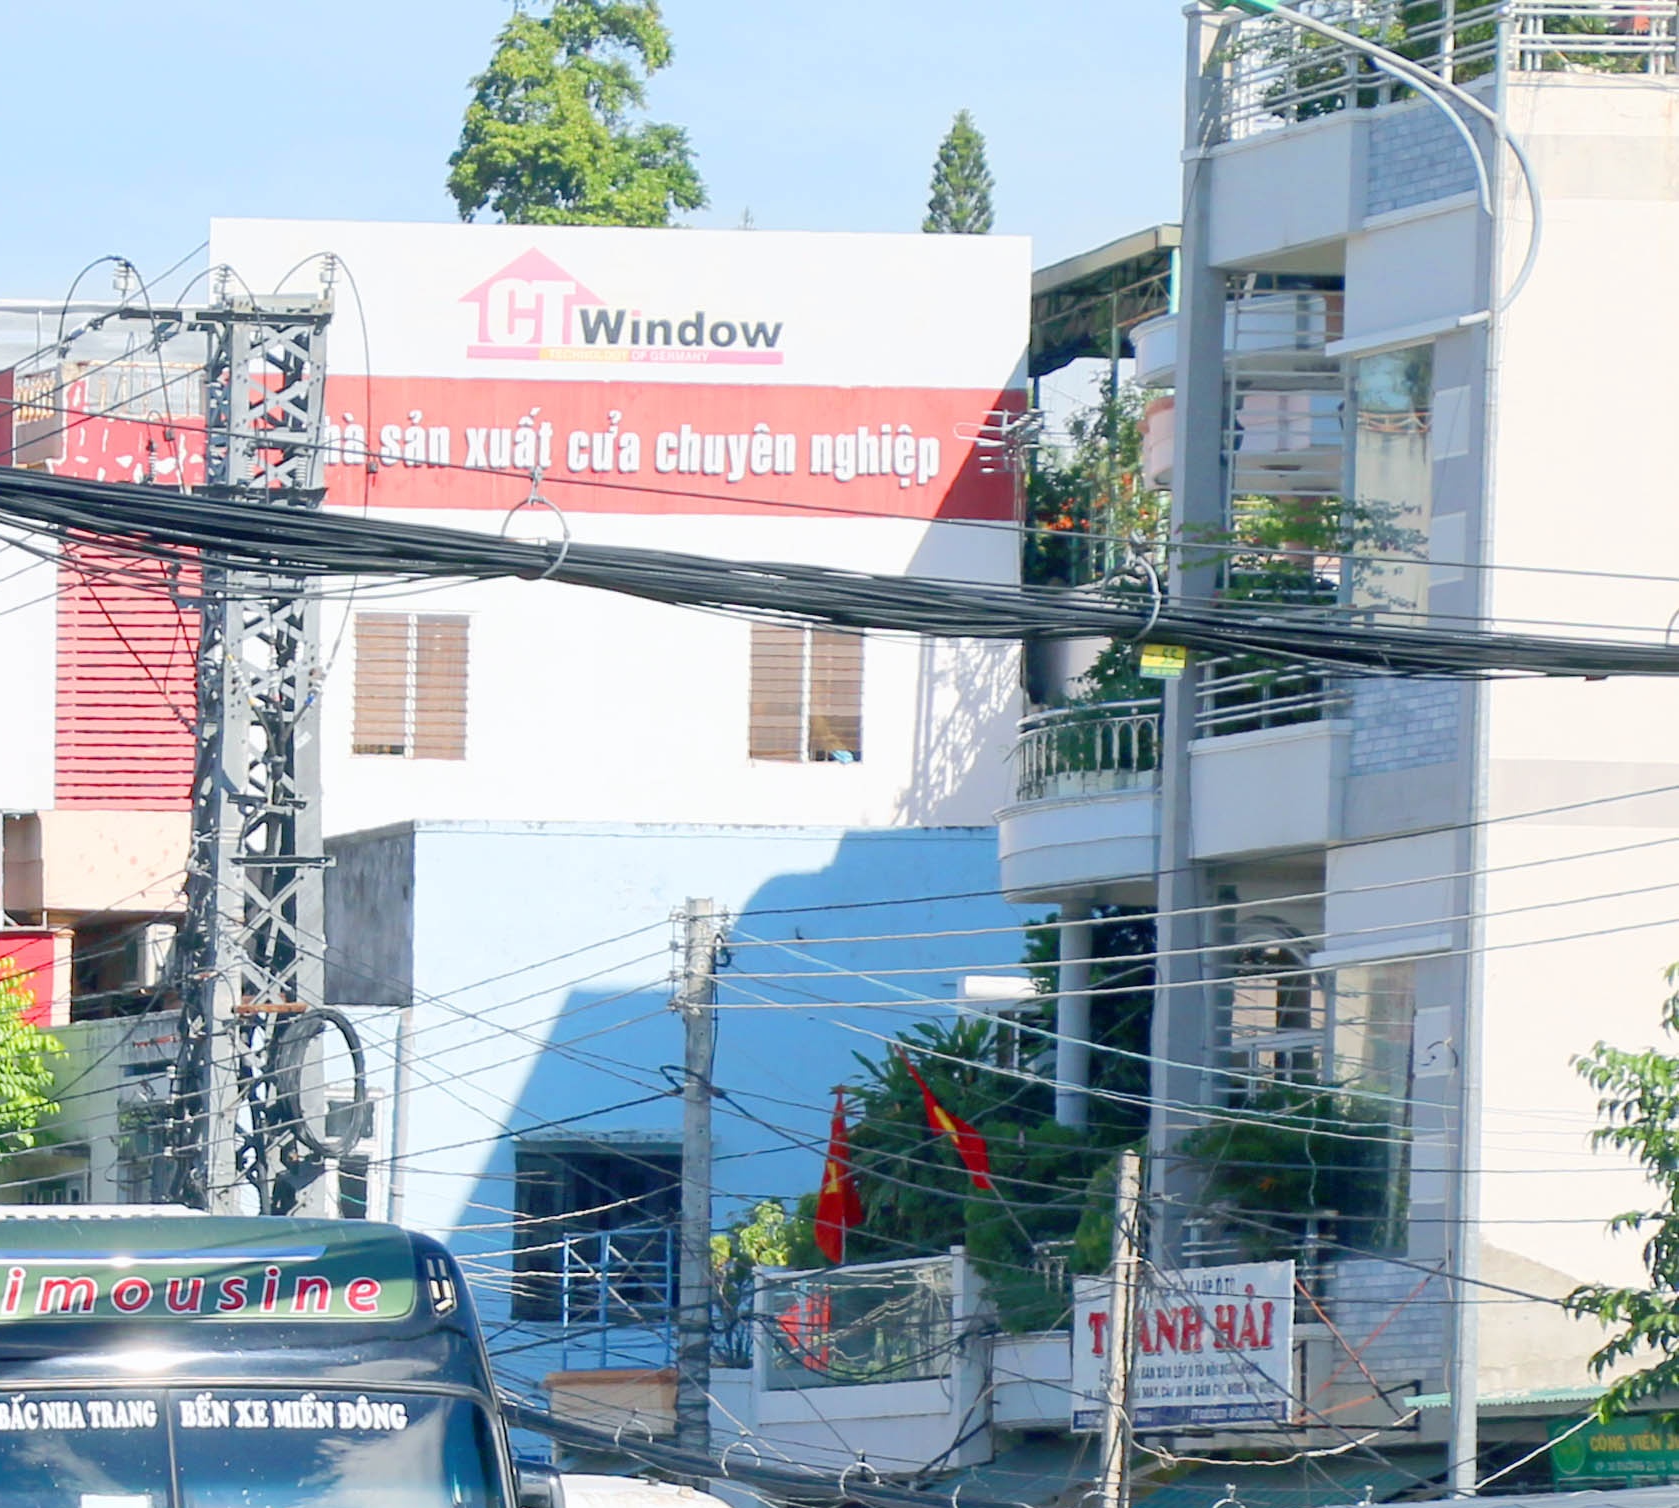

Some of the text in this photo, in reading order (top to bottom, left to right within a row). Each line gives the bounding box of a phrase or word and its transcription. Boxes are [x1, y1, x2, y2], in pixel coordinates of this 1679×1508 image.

[487, 278, 784, 348] CT Window
[631, 350, 646, 362] OF
[649, 350, 710, 363] GERMANY
[324, 407, 941, 489] hà sản xuất cửa chuyên nghiệp
[1088, 1283, 1275, 1357] TANH HẢI
[41, 1401, 86, 1429] NHA
[87, 1400, 158, 1429] TRANG
[179, 1392, 408, 1431] BẾN XE MIỀN ĐÔNG
